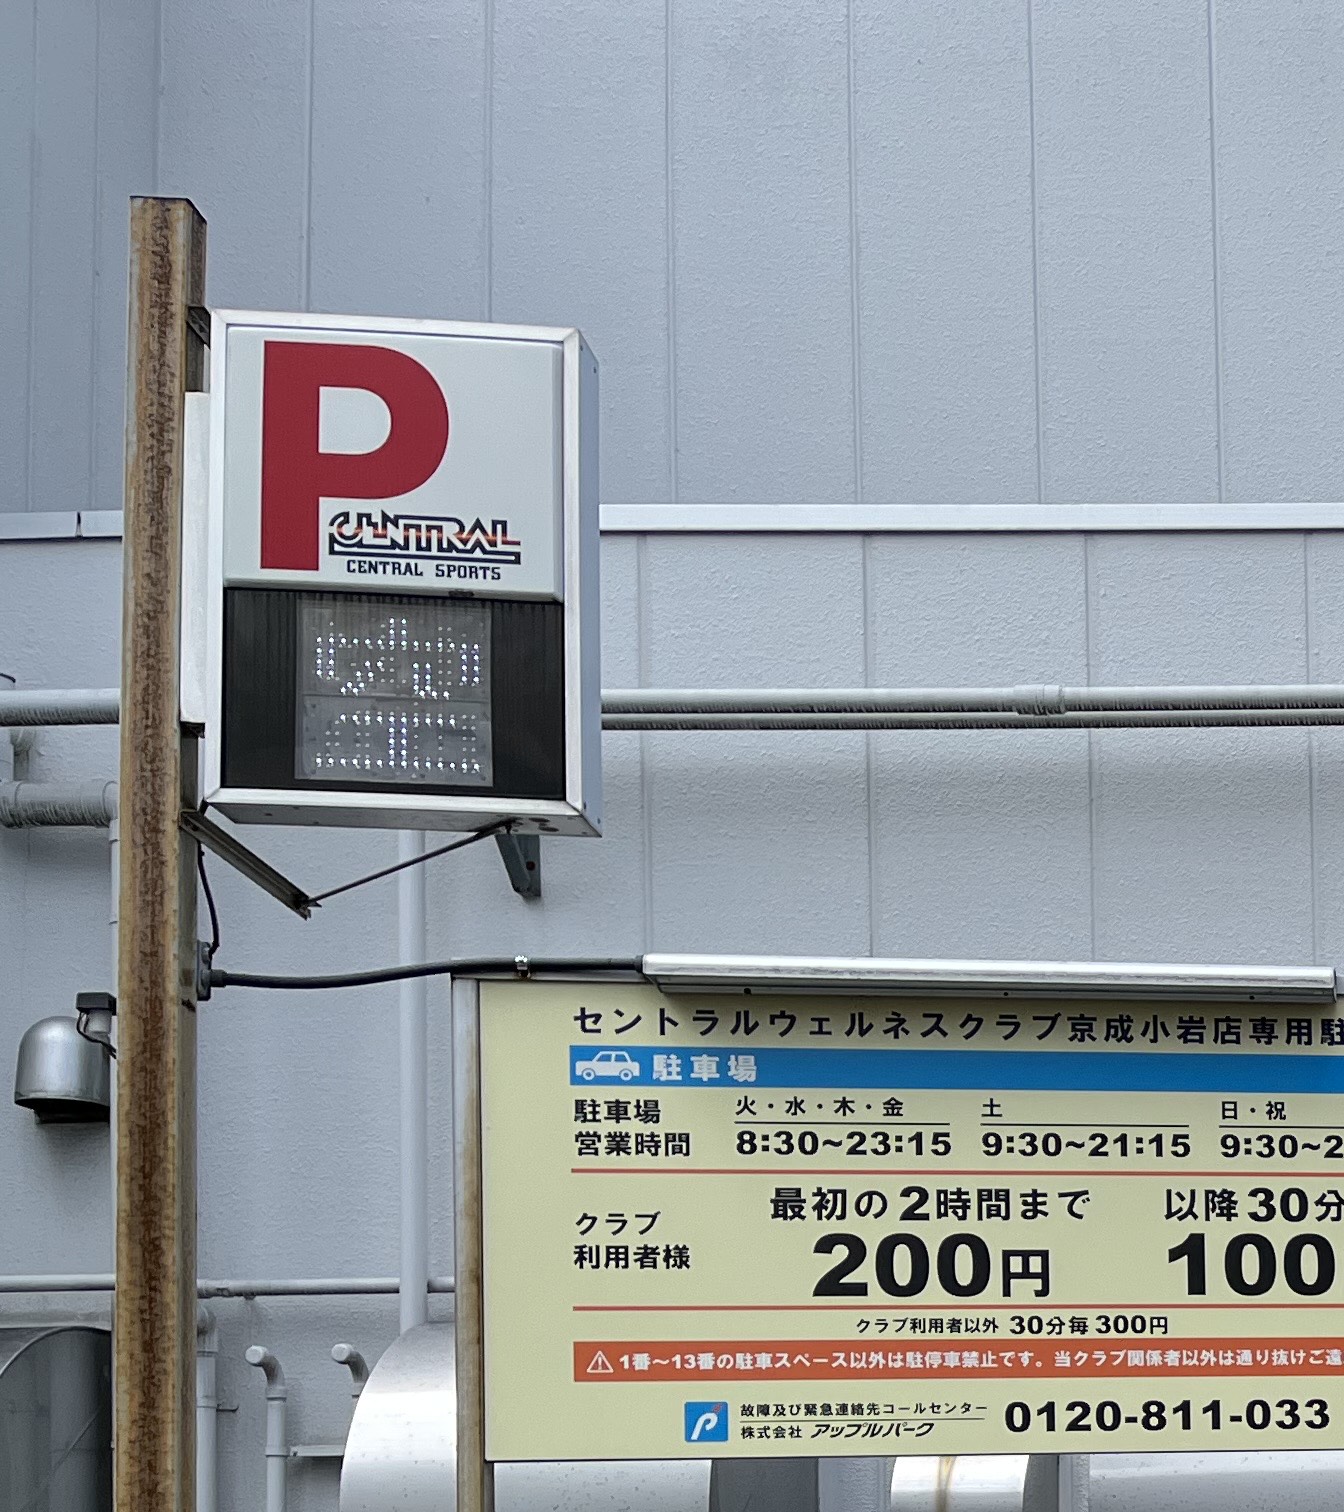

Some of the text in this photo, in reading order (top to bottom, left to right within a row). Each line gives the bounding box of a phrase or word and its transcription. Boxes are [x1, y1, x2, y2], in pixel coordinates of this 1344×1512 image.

[260, 340, 449, 571] P
[347, 560, 502, 581] CENTRAL SPORTS
[652, 1053, 758, 1083] 駐車場
[573, 1098, 661, 1125] 駐車場
[981, 1097, 1003, 1118] 土
[1220, 1100, 1287, 1122] 日・祝
[573, 1131, 691, 1158] 営業時間
[770, 1185, 1092, 1222] 最初の2時間まで
[574, 1211, 662, 1237] クラブ
[573, 1244, 691, 1270] 利用者様
[812, 1232, 1051, 1299] 200円
[740, 1401, 988, 1418] 故障及び緊急連絡先コールセンター
[1004, 1398, 1331, 1434] 0120-811-033
[740, 1420, 935, 1440] 株式会社 アップルパーク
